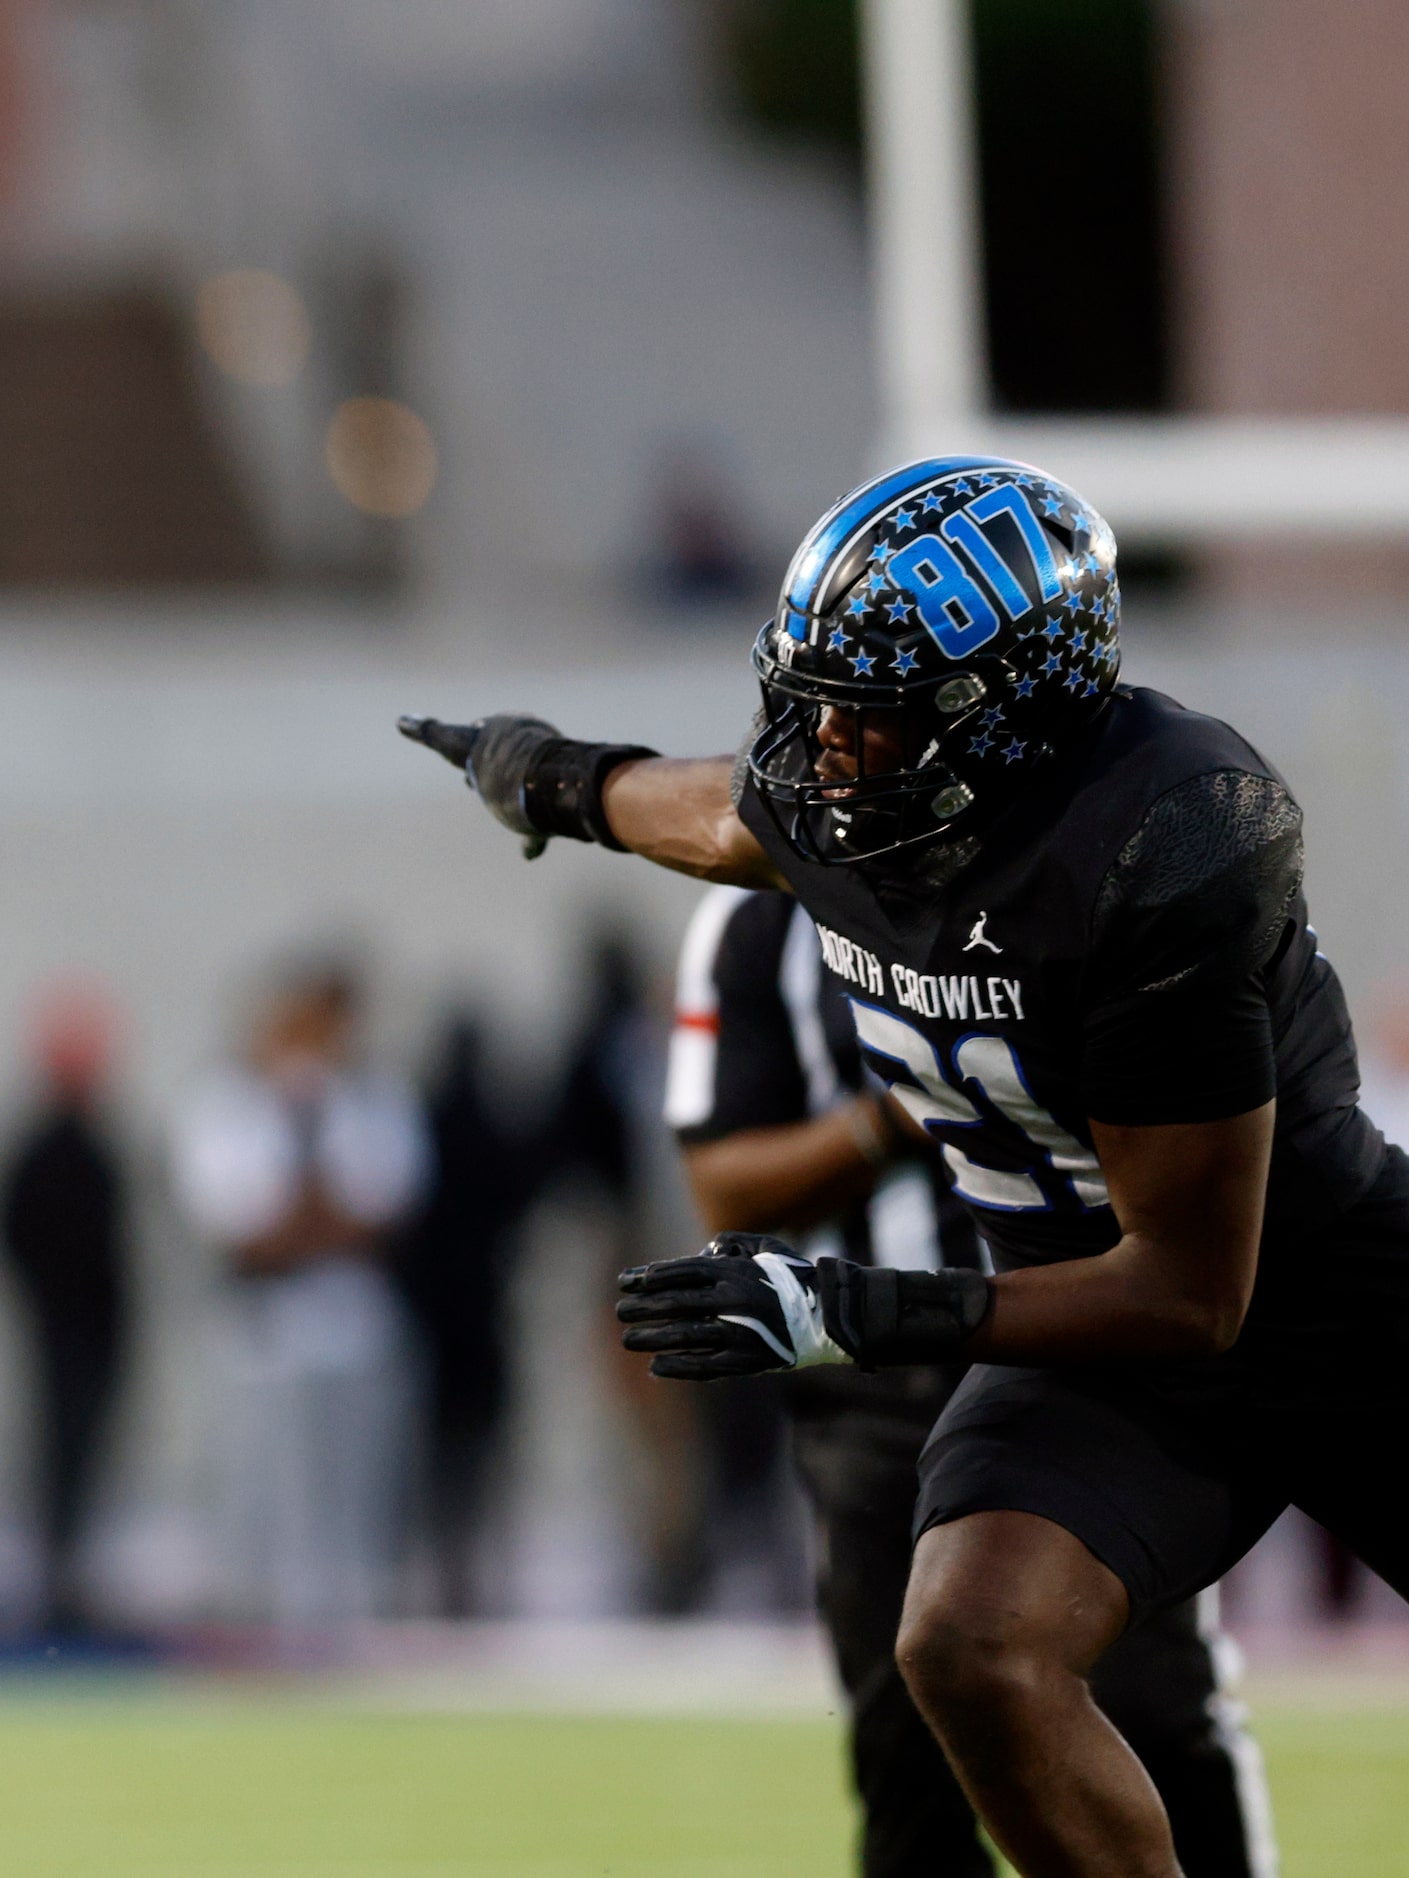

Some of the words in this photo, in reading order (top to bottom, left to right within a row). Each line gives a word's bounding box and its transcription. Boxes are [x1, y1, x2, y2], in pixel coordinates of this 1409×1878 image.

[884, 482, 1064, 661] 817
[815, 921, 885, 997] NORTH
[890, 962, 1025, 1021] CROWLEY
[843, 992, 1112, 1213] 21
